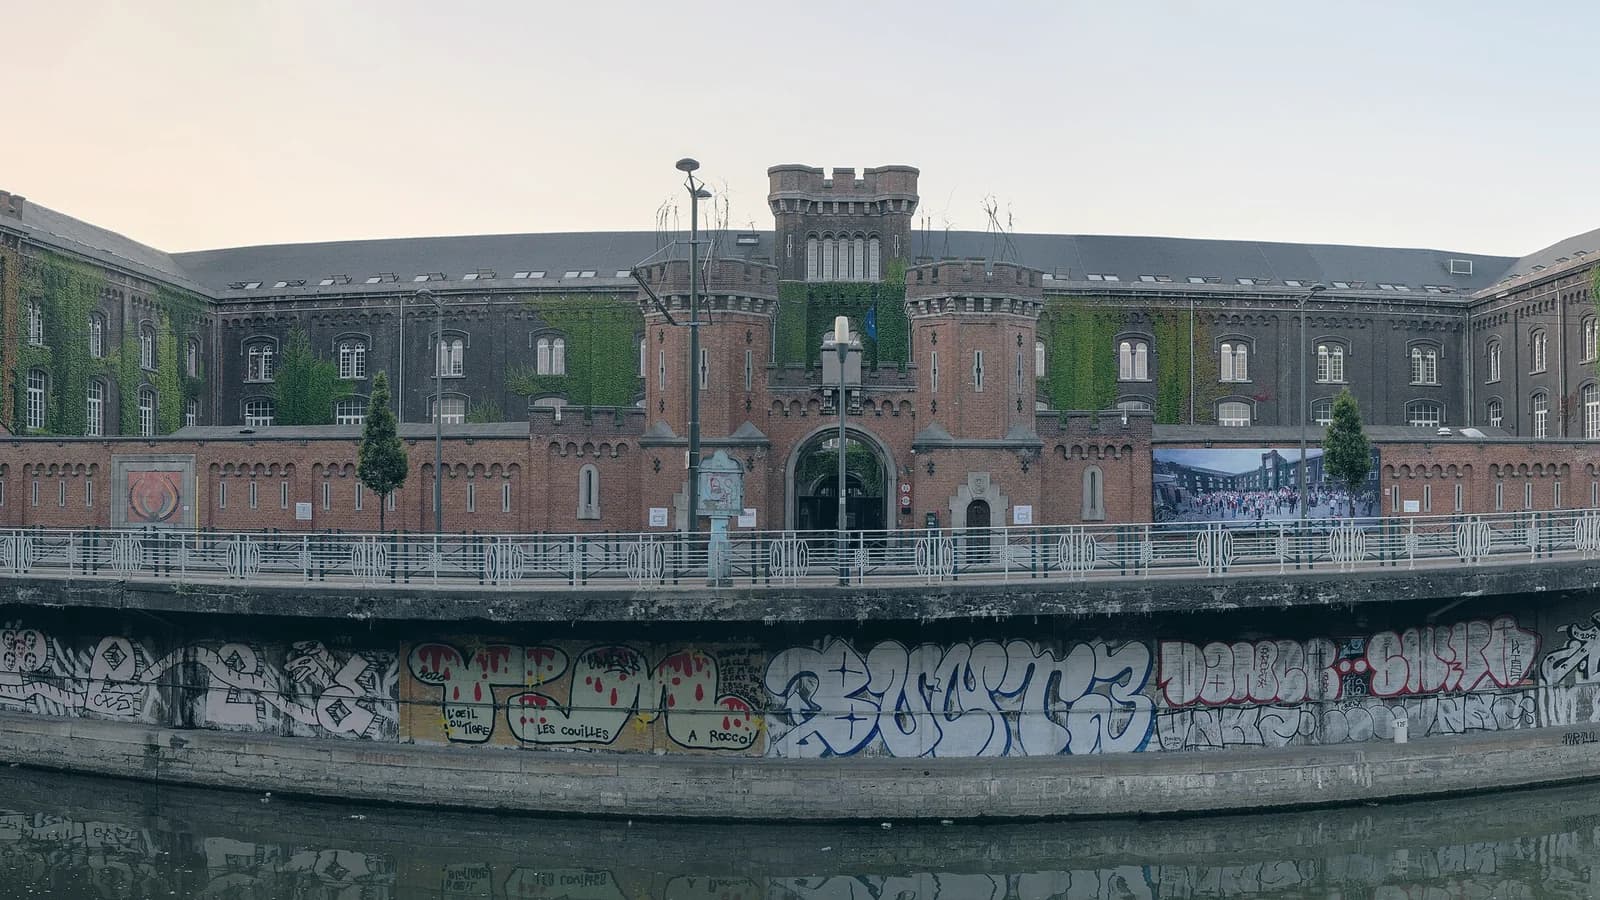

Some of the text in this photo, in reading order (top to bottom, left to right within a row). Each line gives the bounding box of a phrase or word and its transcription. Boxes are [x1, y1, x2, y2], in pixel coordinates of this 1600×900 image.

[462, 721, 490, 736] TIGRE
[537, 724, 556, 735] LES
[688, 729, 698, 742] A
